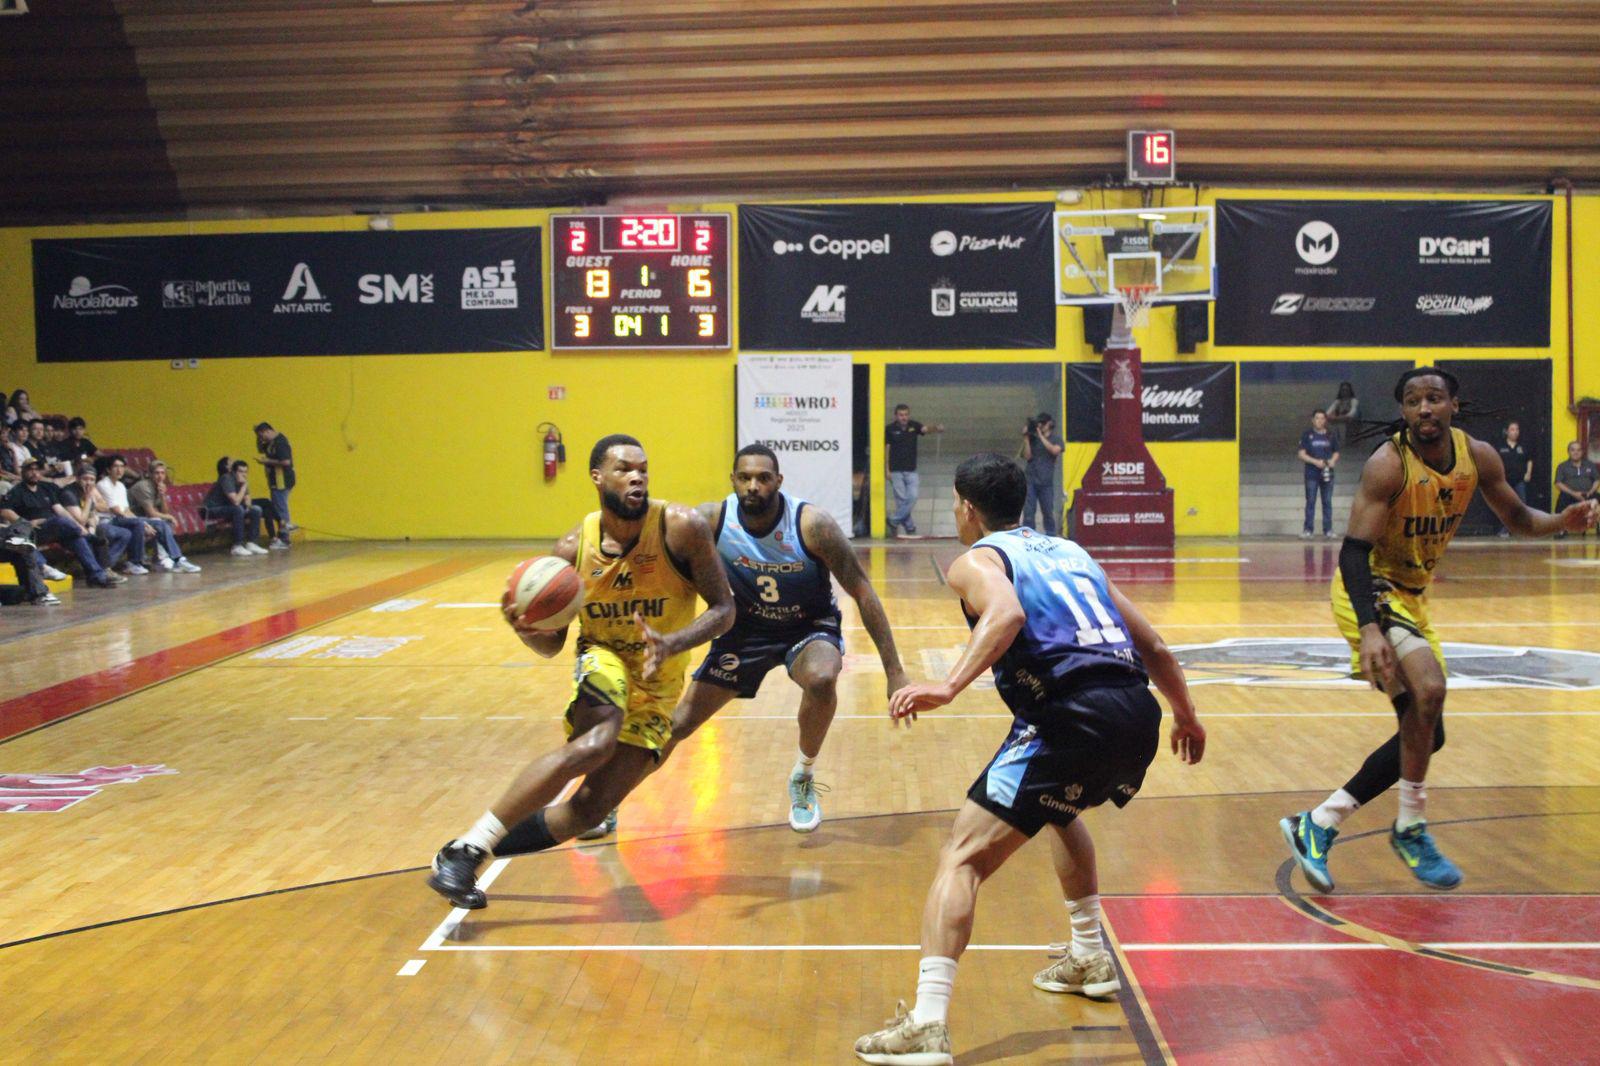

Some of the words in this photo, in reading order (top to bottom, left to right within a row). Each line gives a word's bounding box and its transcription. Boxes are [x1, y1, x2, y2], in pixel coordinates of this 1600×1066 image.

[1145, 136, 1169, 163] 16
[571, 230, 585, 252] 2
[621, 219, 675, 245] 2:20
[695, 229, 709, 251] 2
[809, 234, 890, 259] Coppel
[959, 235, 997, 251] Pizza
[998, 235, 1025, 249] Hut
[1419, 237, 1490, 256] D'Gari
[566, 256, 612, 267] GUEST
[671, 255, 713, 266] HOME
[462, 259, 516, 289] ASÍ
[641, 265, 648, 286] 1
[358, 274, 418, 304] SM
[620, 289, 661, 299] PERIOD
[273, 303, 332, 313] ANTARTIC
[565, 306, 592, 314] FOULS
[574, 315, 589, 337] 3
[614, 315, 641, 336] 04
[661, 315, 668, 336] 1
[698, 314, 714, 336] 3
[1114, 462, 1145, 475] ISDE
[756, 576, 780, 603] 3
[1048, 577, 1127, 646] 11
[709, 667, 738, 683] MEGA
